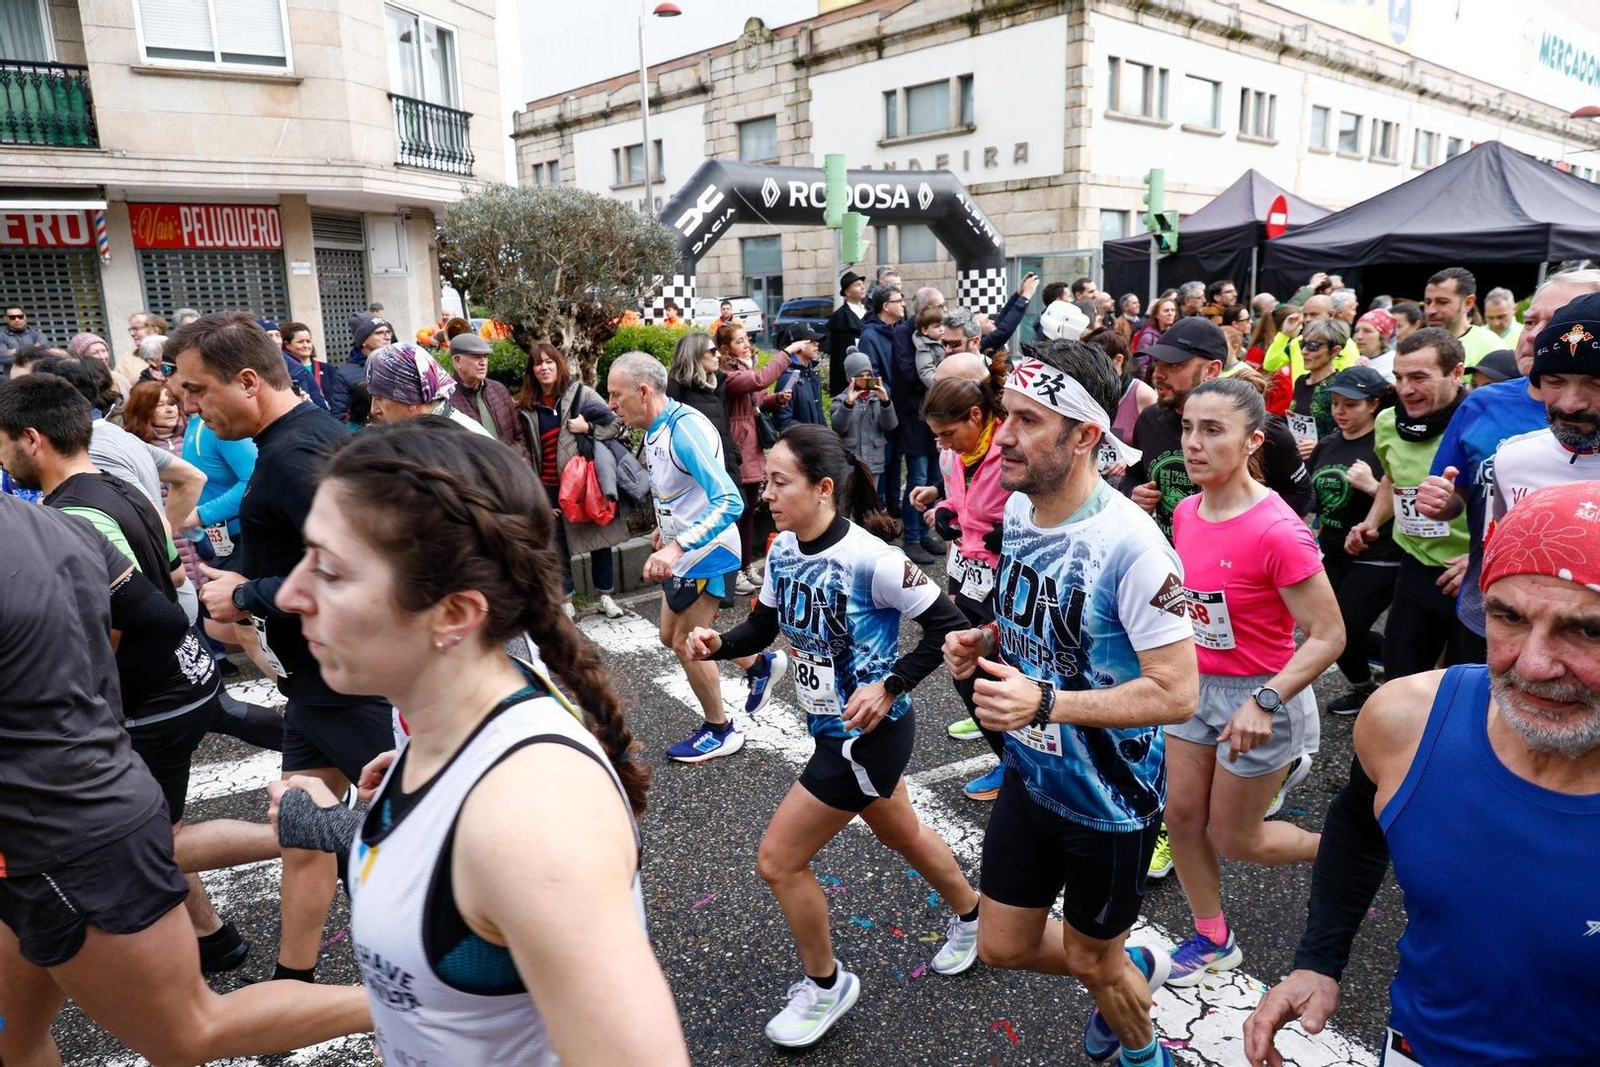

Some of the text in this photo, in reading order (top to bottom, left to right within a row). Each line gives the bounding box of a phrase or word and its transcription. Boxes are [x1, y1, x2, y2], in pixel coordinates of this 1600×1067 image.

[788, 180, 910, 209] ROOSA
[179, 206, 282, 248] PELUQUERO
[691, 208, 736, 255] DACIA
